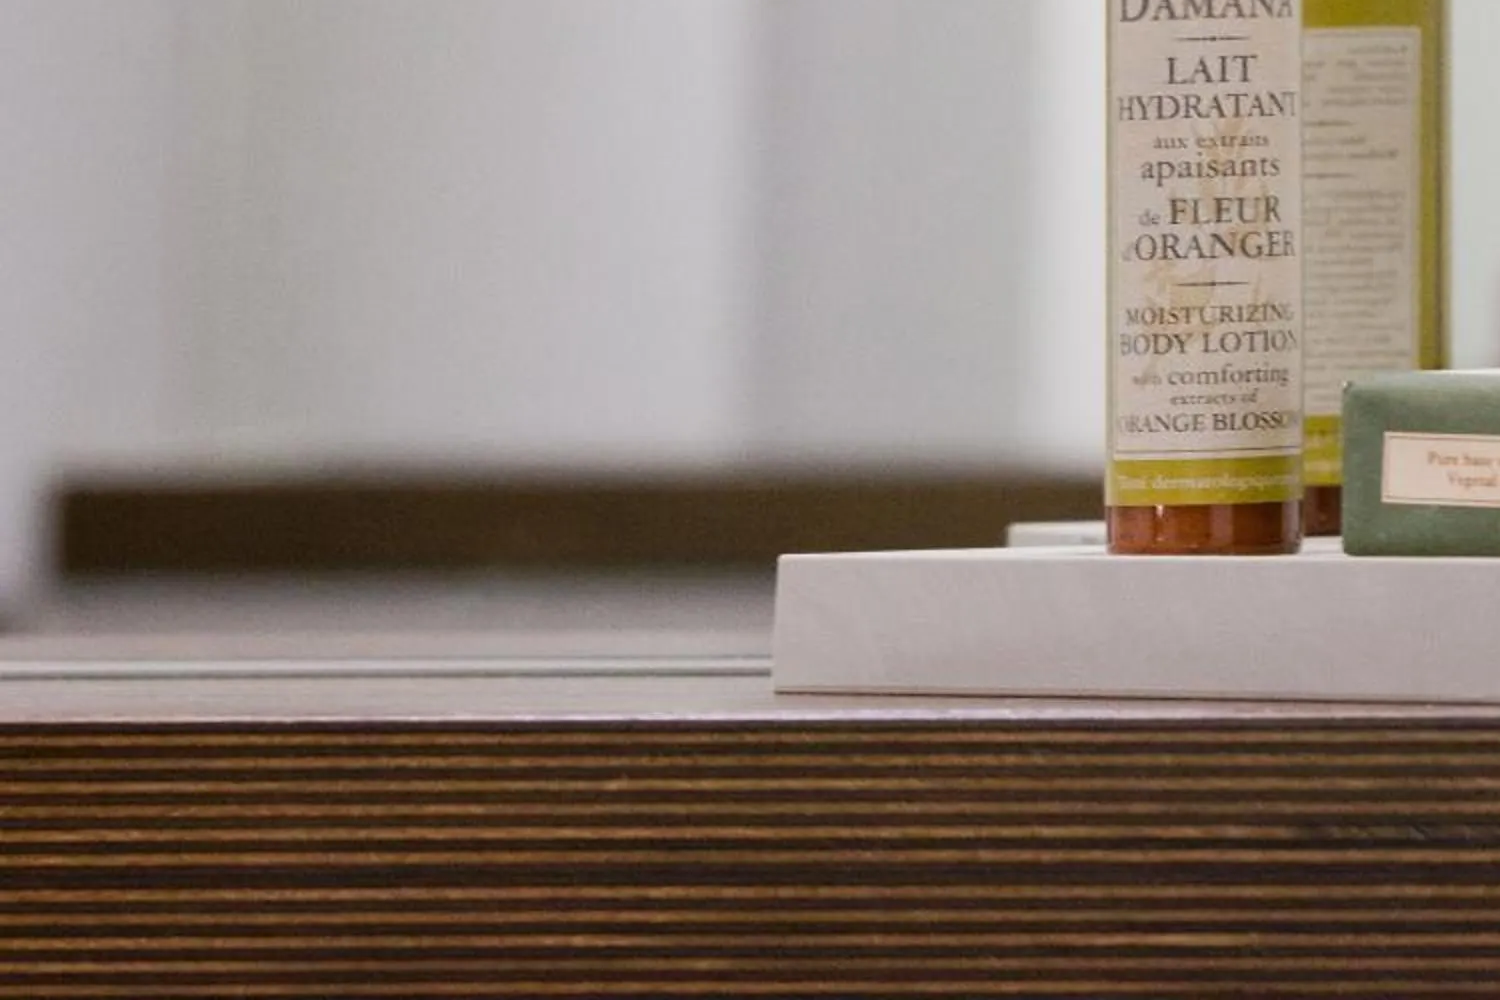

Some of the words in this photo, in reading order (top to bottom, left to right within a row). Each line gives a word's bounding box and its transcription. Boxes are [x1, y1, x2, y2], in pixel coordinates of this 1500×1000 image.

[1166, 54, 1258, 84] LAIT
[1118, 91, 1296, 121] HYDRATANT
[1153, 135, 1189, 149] aux
[1140, 152, 1281, 187] apaisants
[1139, 208, 1161, 226] de
[1169, 195, 1281, 225] FLEUR
[1120, 332, 1194, 356] BODY
[1168, 363, 1289, 387] comforting
